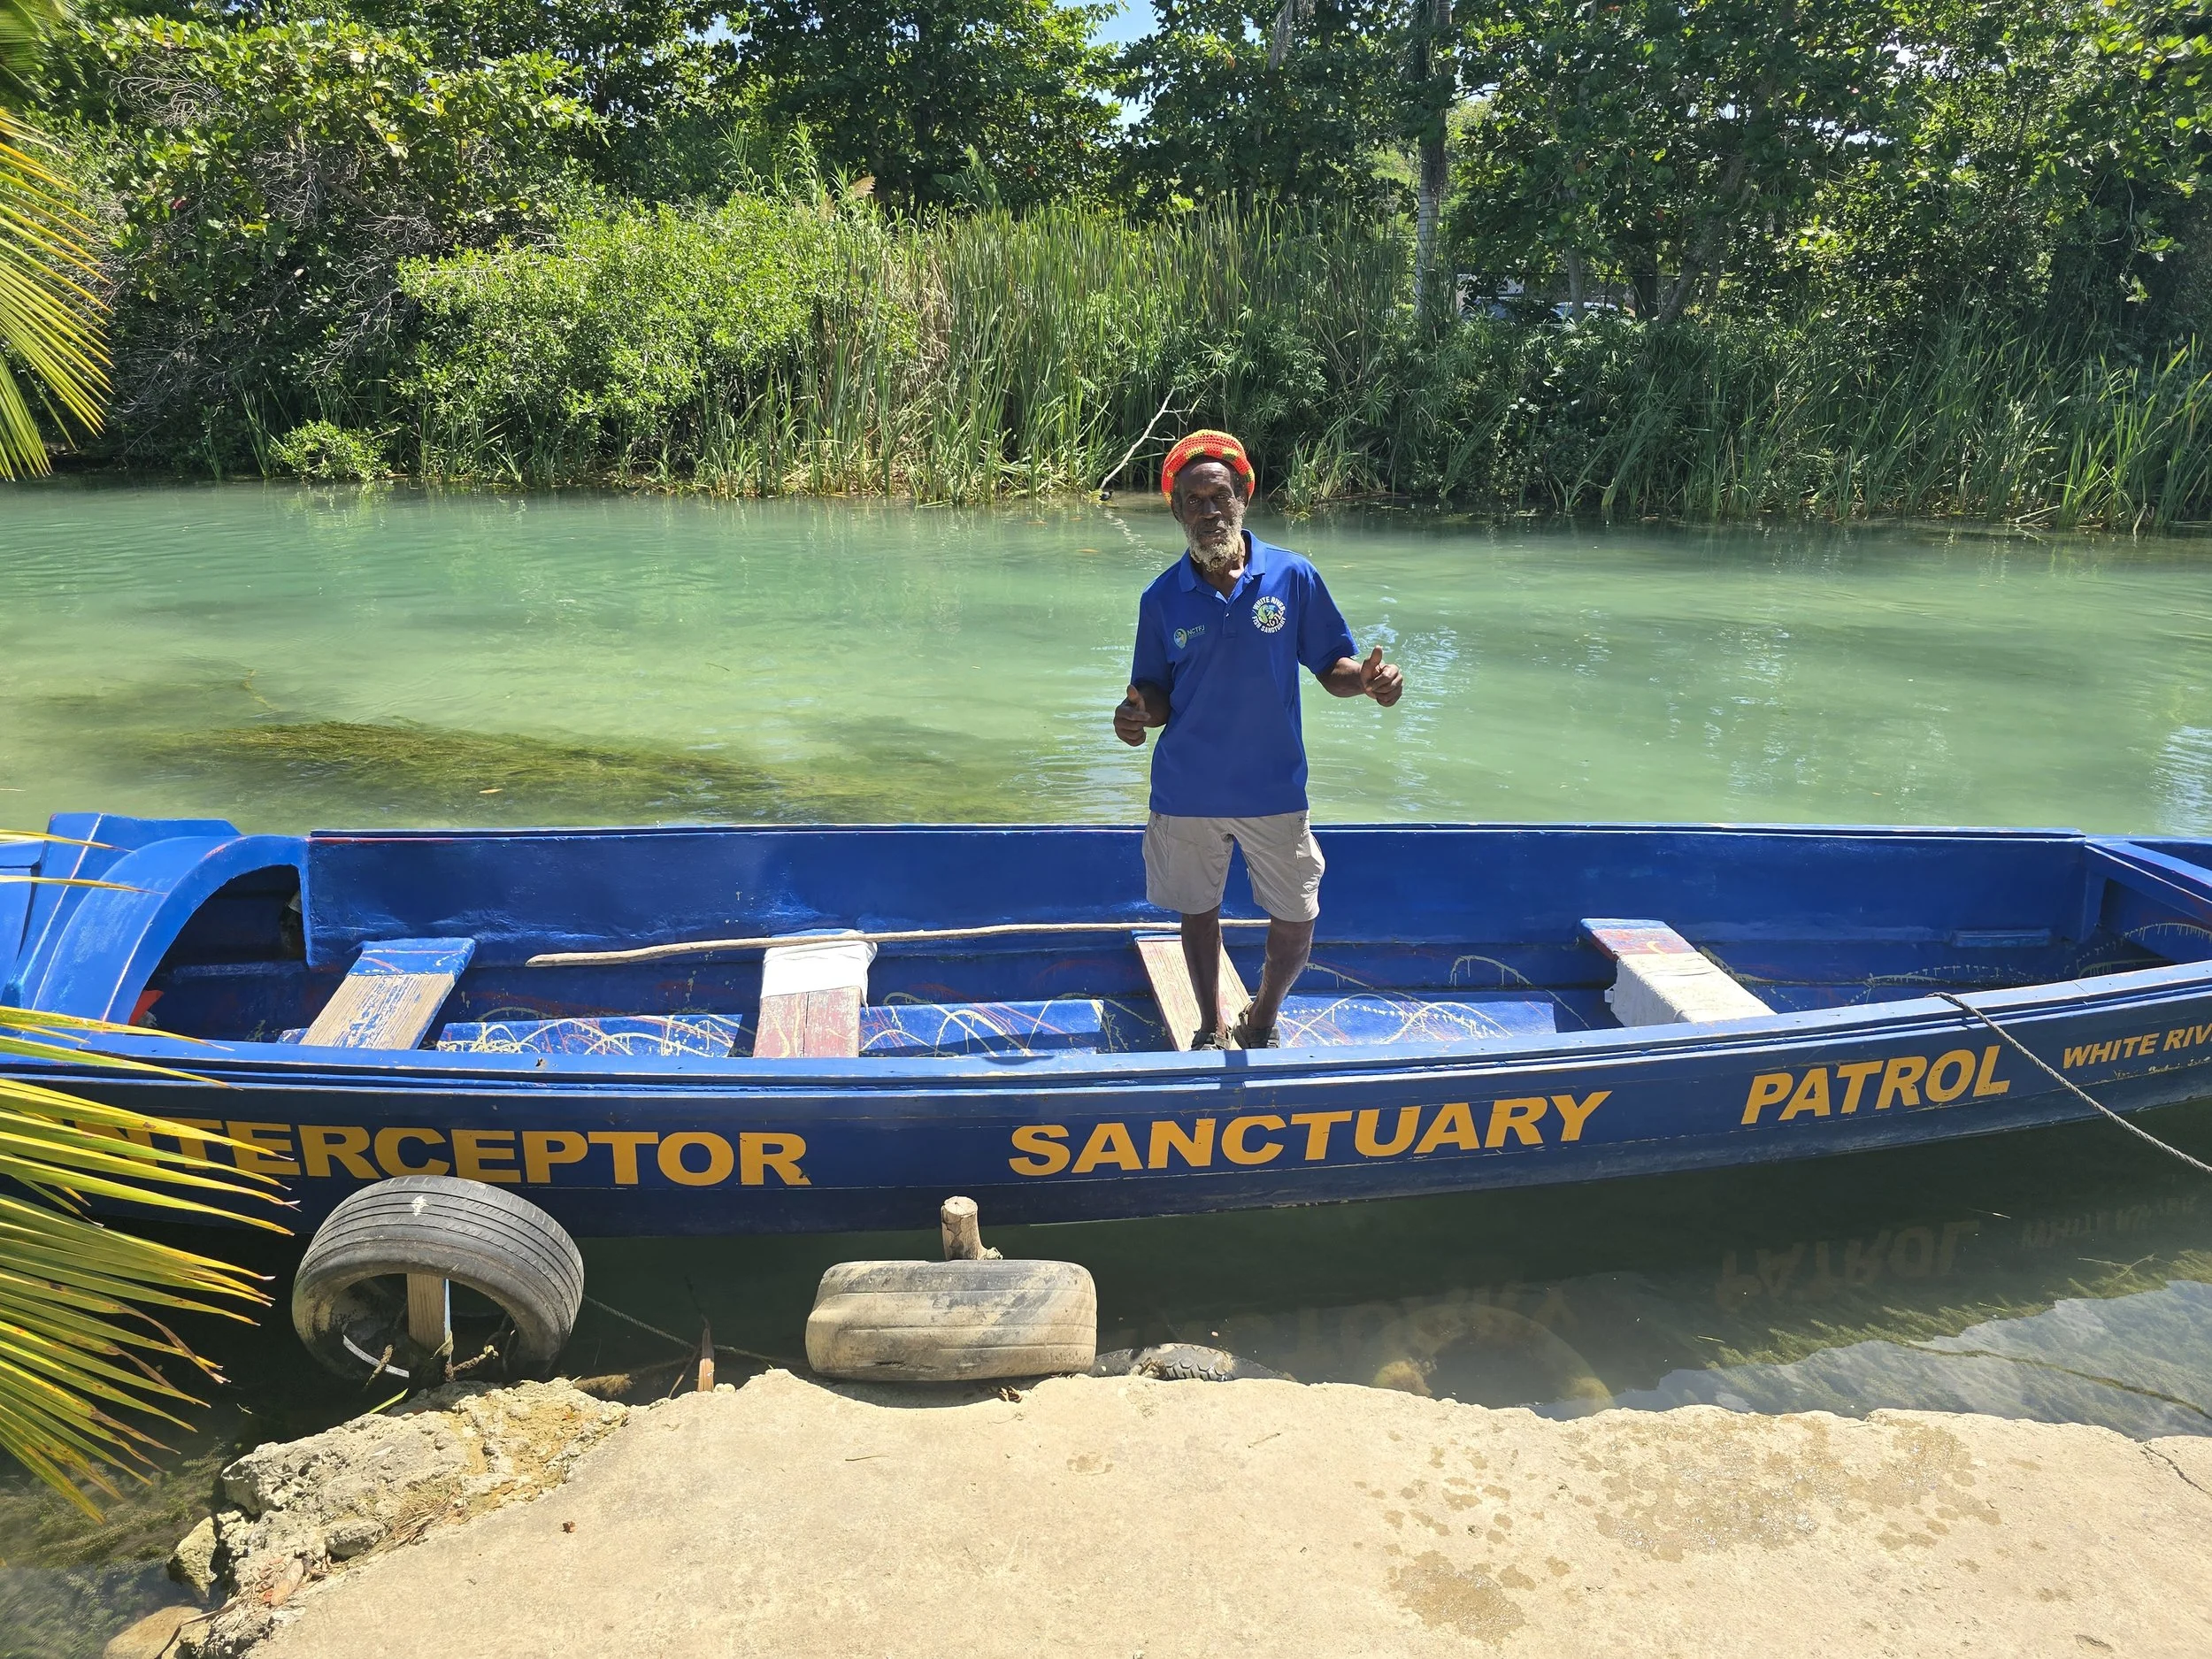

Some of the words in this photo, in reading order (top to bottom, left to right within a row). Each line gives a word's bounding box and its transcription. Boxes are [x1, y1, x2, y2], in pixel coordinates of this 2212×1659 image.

[1253, 596, 1270, 610] WHITE
[1271, 596, 1286, 611] RIVER
[1252, 616, 1262, 628] FISH
[1261, 617, 1286, 633] SANCTUARY
[2062, 1033, 2160, 1069] WHITE
[2163, 1023, 2212, 1051] RIV
[44, 1114, 811, 1186] NTERCEPTOR
[1009, 1091, 1612, 1176] SANCTUARY
[1741, 1046, 2010, 1125] PATROL
